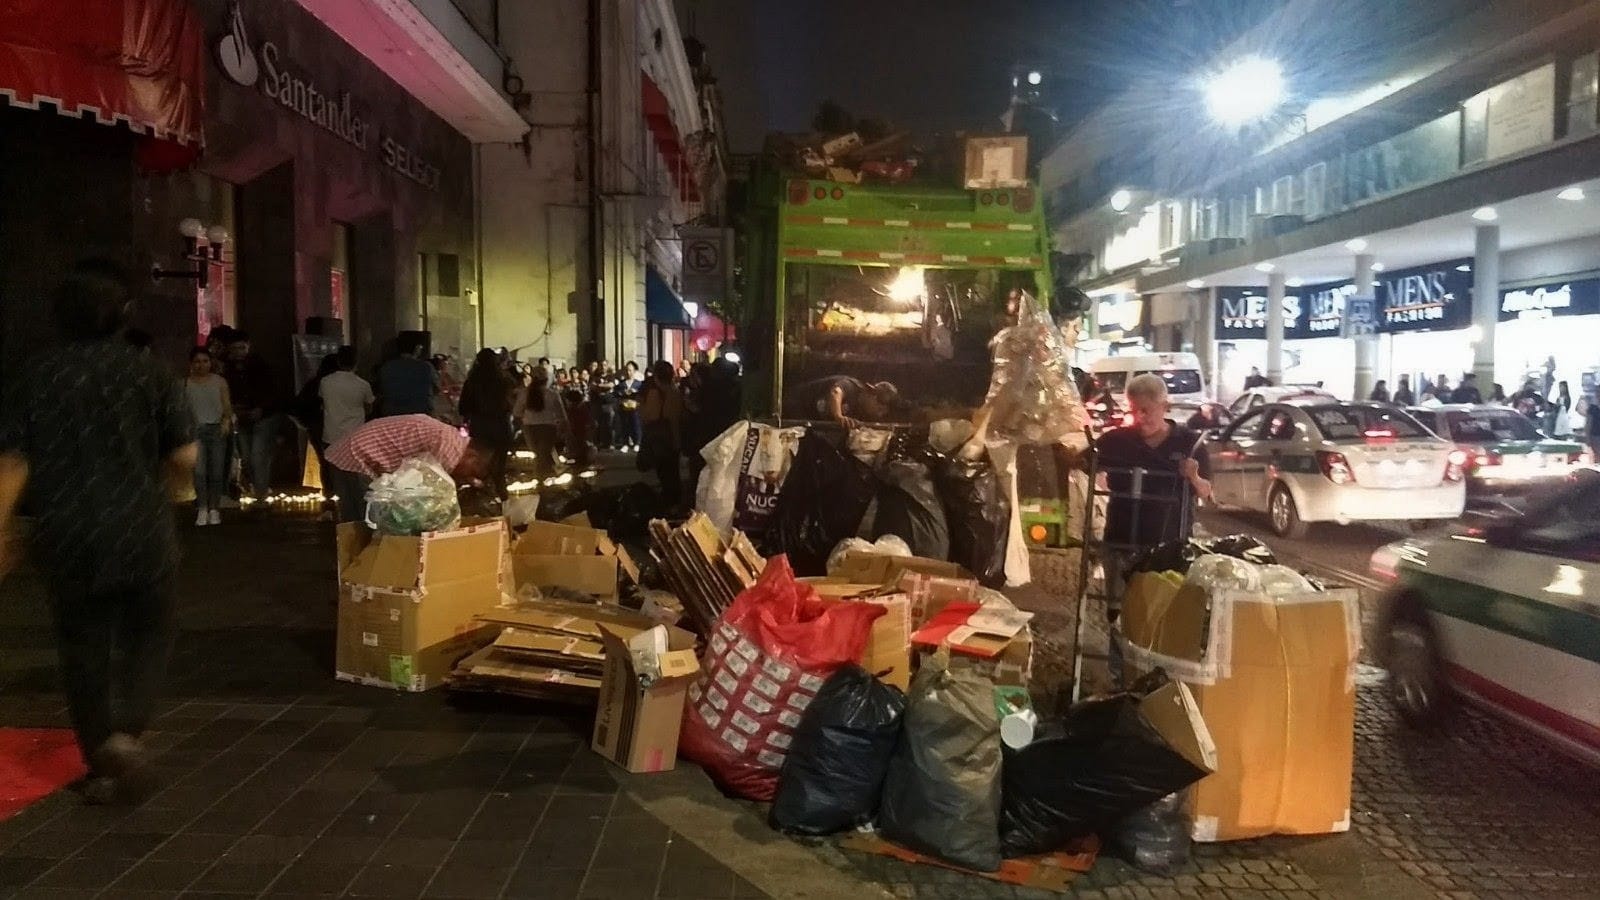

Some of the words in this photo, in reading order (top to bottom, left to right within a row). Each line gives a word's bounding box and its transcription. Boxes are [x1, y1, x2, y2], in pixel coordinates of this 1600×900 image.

[262, 42, 369, 150] Santander
[382, 137, 441, 192] SELECT
[1386, 271, 1446, 306] MENS
[1221, 295, 1302, 319] MES
